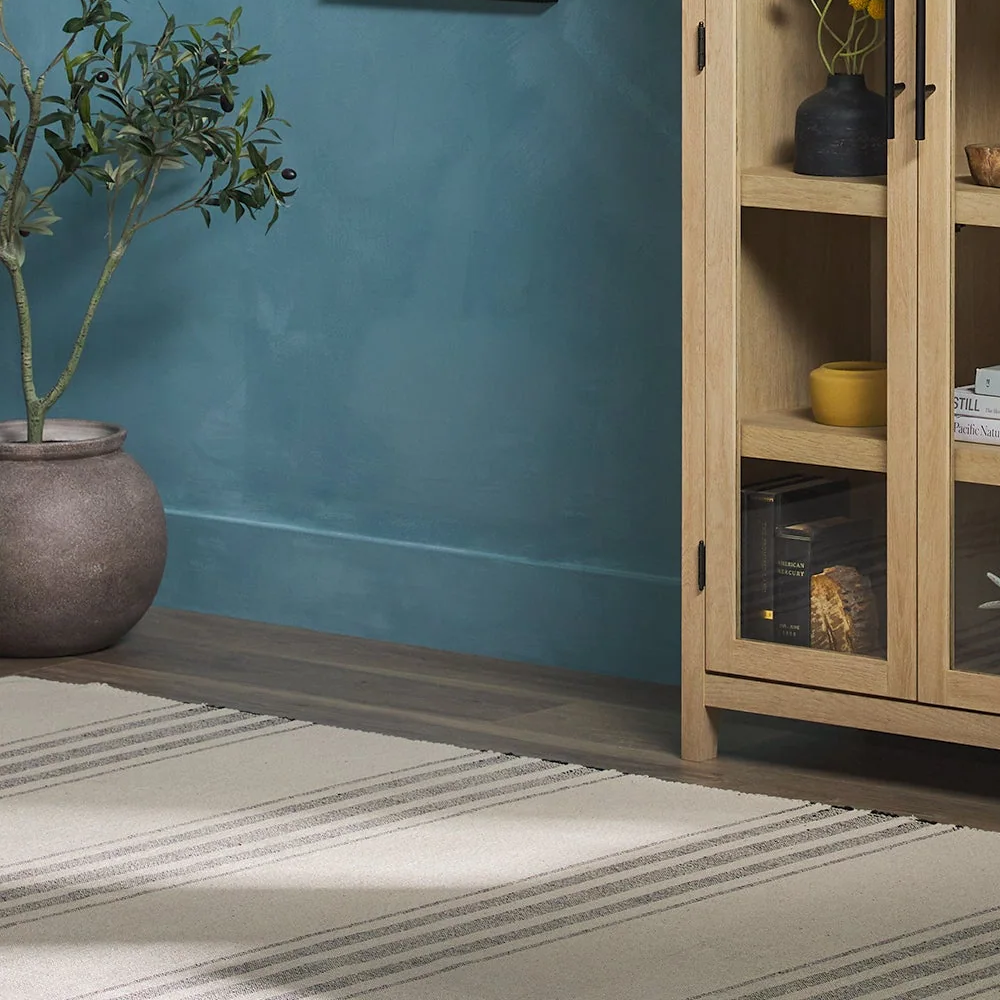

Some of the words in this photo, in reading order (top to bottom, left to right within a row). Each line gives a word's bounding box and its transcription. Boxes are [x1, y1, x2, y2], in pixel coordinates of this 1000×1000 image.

[954, 396, 980, 412] STILL
[954, 421, 980, 437] Pacific
[777, 560, 805, 569] AMERICAN
[777, 569, 805, 577] MERCURY
